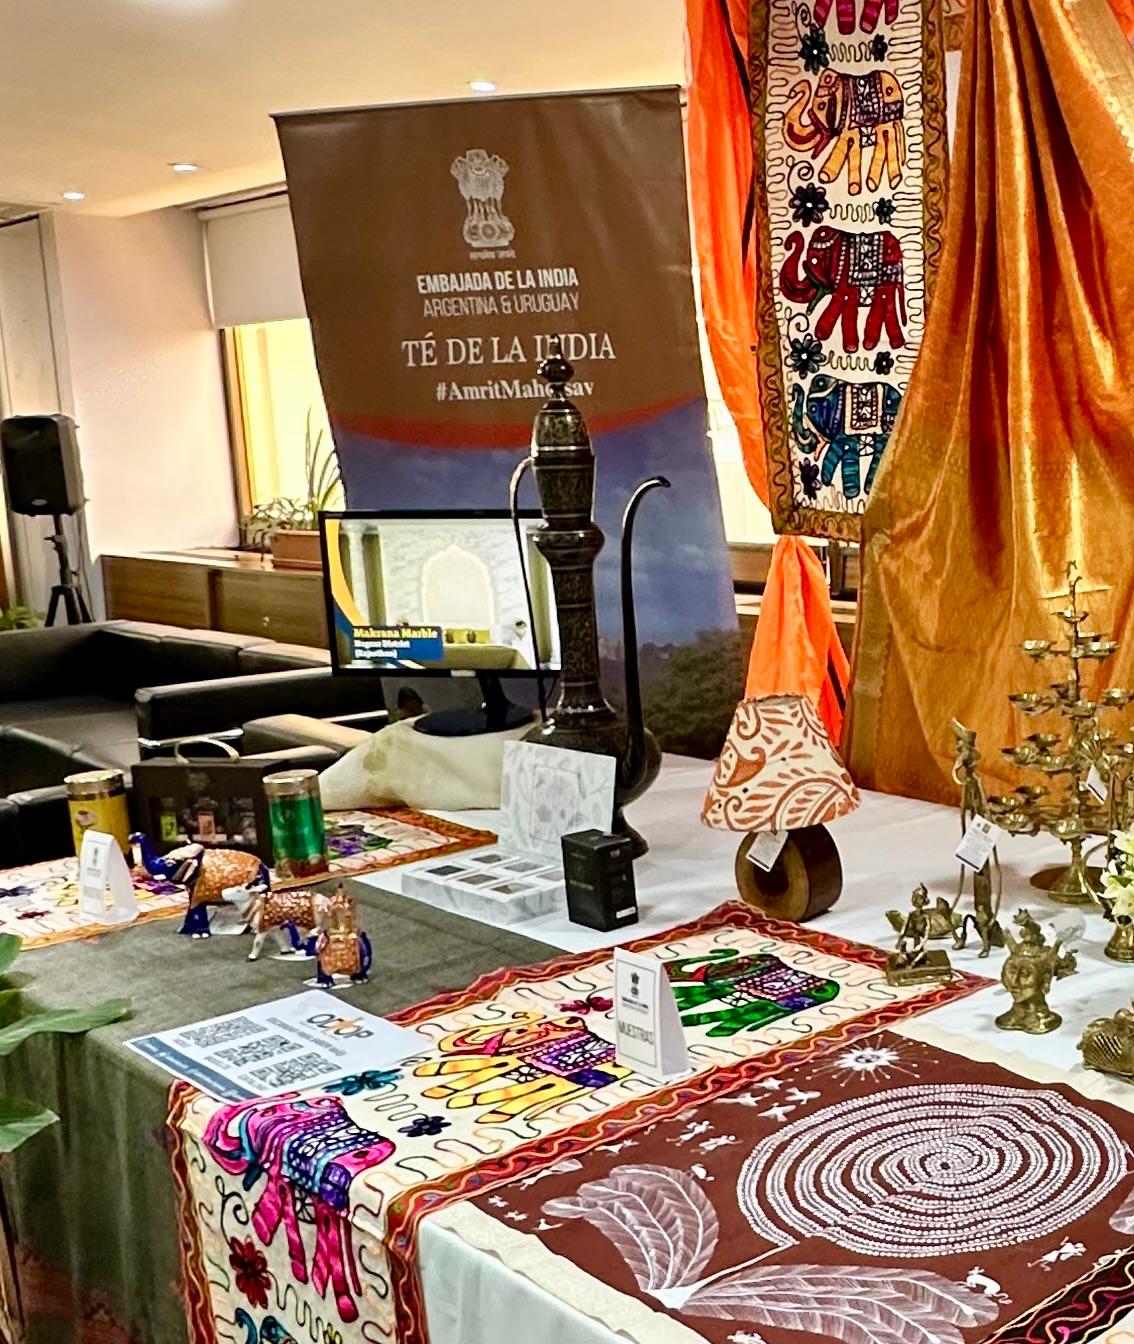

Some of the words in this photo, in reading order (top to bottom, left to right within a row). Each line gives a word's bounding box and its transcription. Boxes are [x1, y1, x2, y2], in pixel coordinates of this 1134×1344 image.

[417, 271, 492, 294] EMBAJADA
[494, 270, 515, 290] DE
[517, 269, 536, 289] LA
[537, 267, 579, 288] INDIA
[423, 296, 499, 318] ARGENTINA
[501, 295, 512, 314] &
[513, 292, 580, 314] URUGUAY
[401, 332, 438, 367] TÉ
[446, 337, 484, 365] DE
[491, 336, 527, 364] LA
